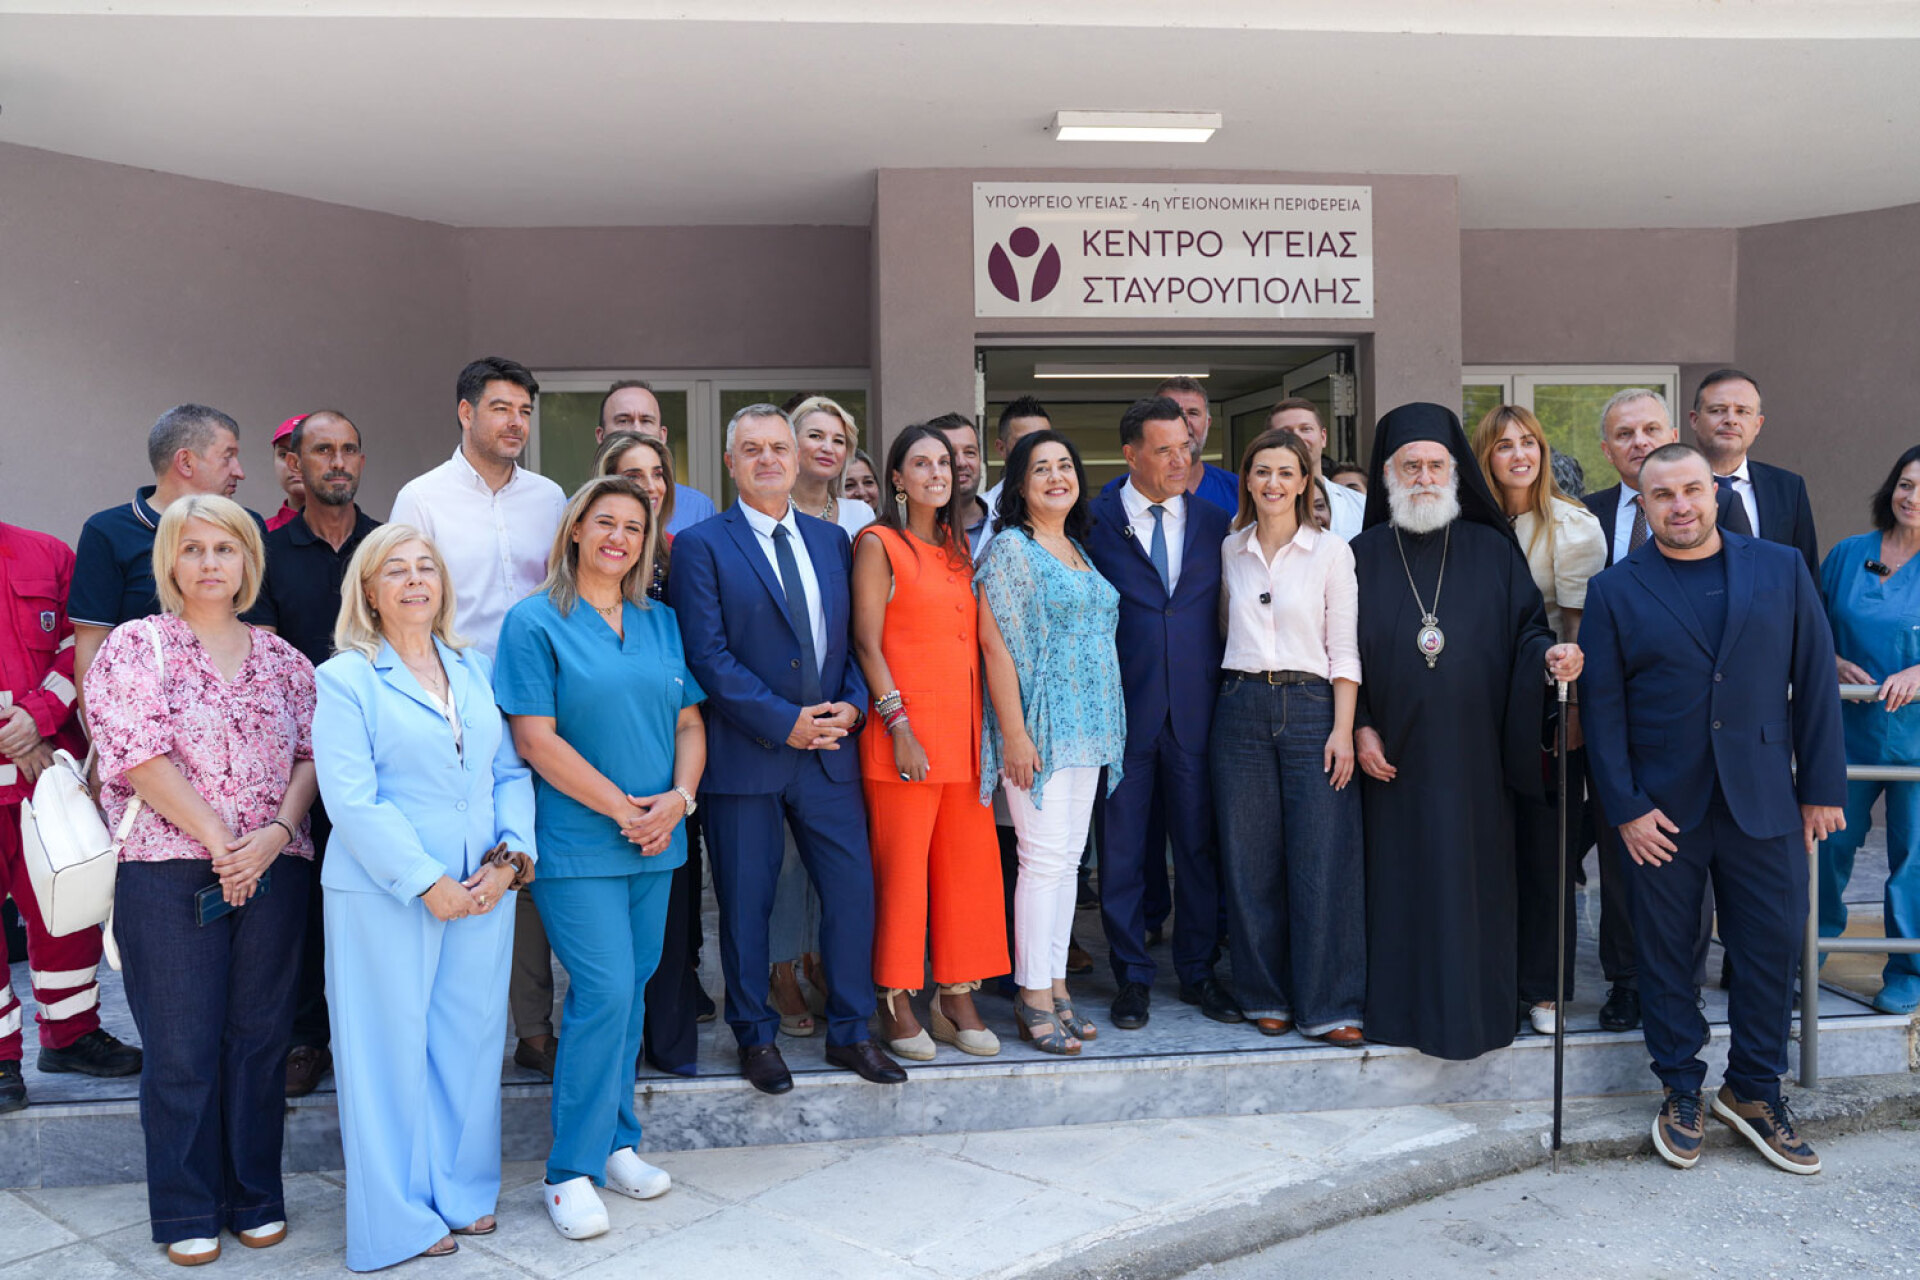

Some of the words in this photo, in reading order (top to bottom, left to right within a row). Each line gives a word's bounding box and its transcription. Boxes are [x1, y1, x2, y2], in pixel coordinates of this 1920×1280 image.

[985, 195, 1073, 209] ΥΠΟΥΡΓΕΙΟ
[1076, 196, 1128, 210] ΥΓΕΙΑΣ
[1141, 197, 1160, 212] 4η
[1164, 197, 1270, 211] ΥΓΕΙΟΝΟΜΙΚΗ
[1274, 198, 1361, 212] ΠΕΡΙΦΕΡΕΙΑ
[1082, 229, 1224, 258] ΚΕΝΤΡΟ
[1242, 230, 1359, 259] ΥΓΕΙΑΣ
[1082, 276, 1362, 304] ΣΤΑΥΡΟΥΠΟΛΗΣ
